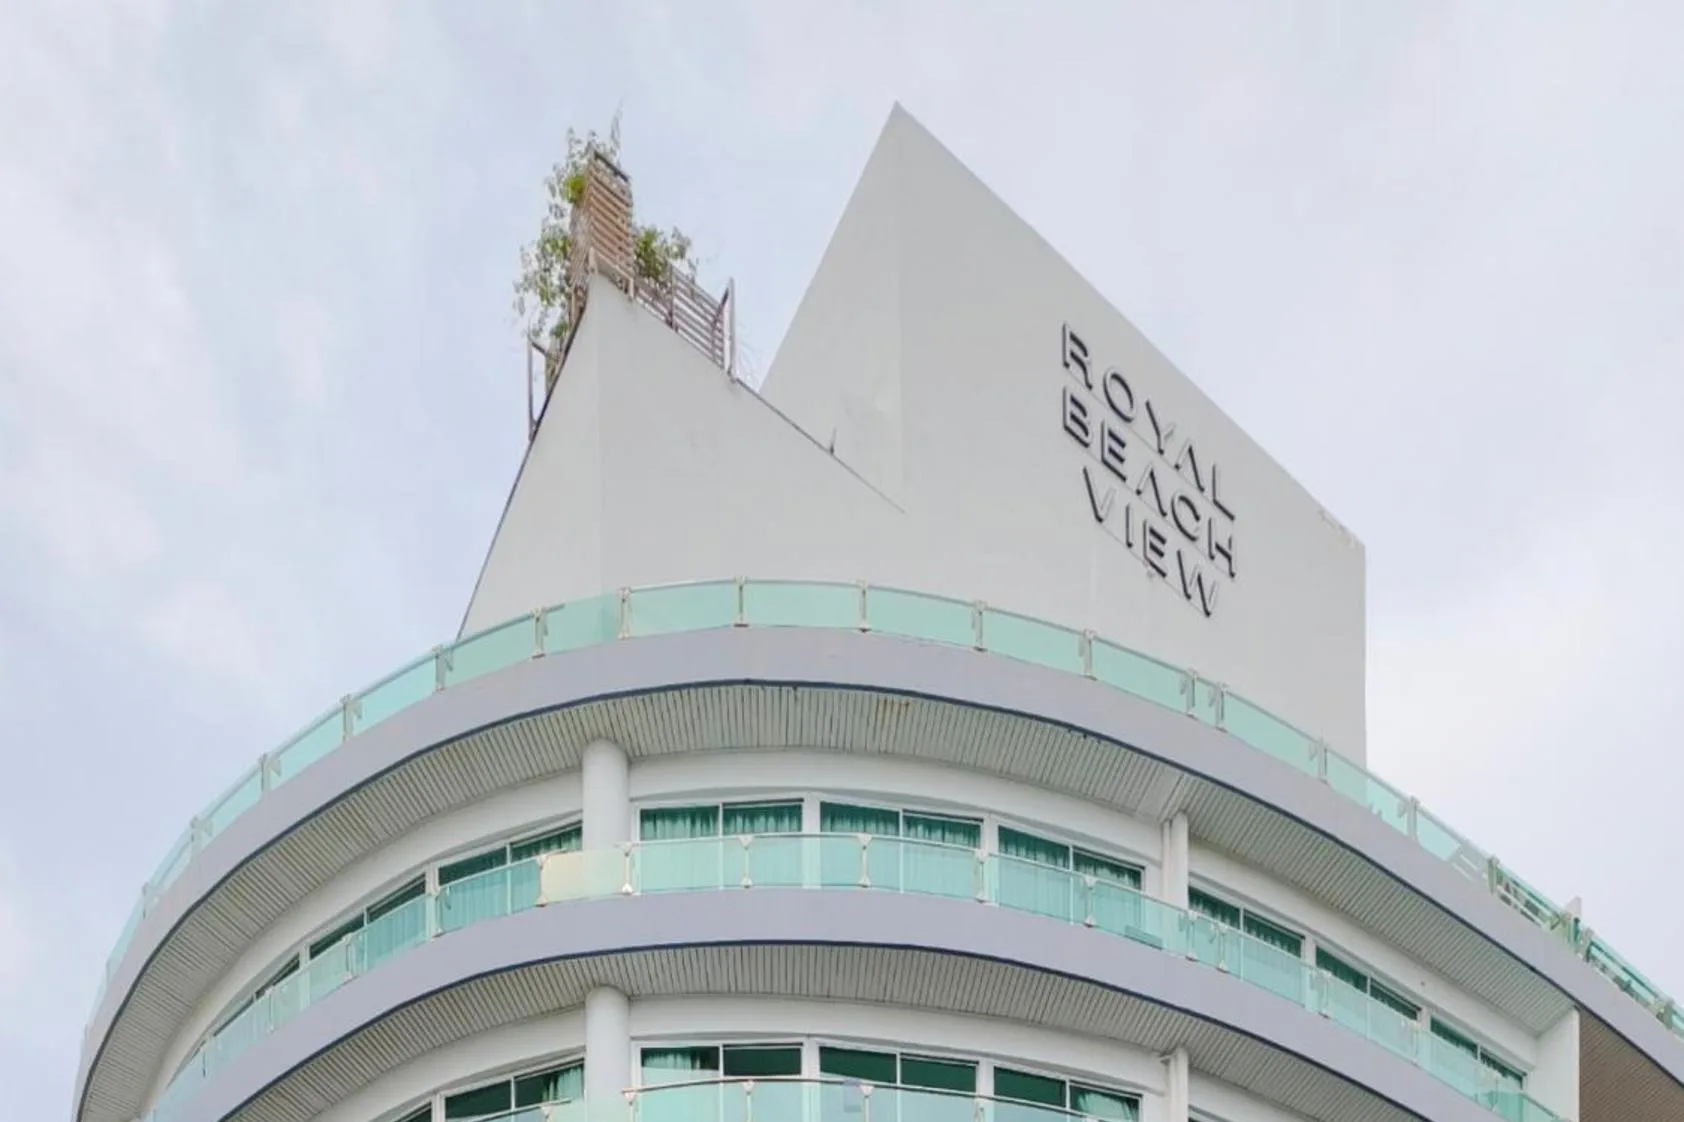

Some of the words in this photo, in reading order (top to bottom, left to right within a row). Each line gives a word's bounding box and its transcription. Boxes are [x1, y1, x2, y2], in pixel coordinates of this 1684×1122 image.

[1062, 322, 1236, 523] ROYAL
[1062, 386, 1236, 580] BEACH
[1082, 465, 1218, 618] VIEW
